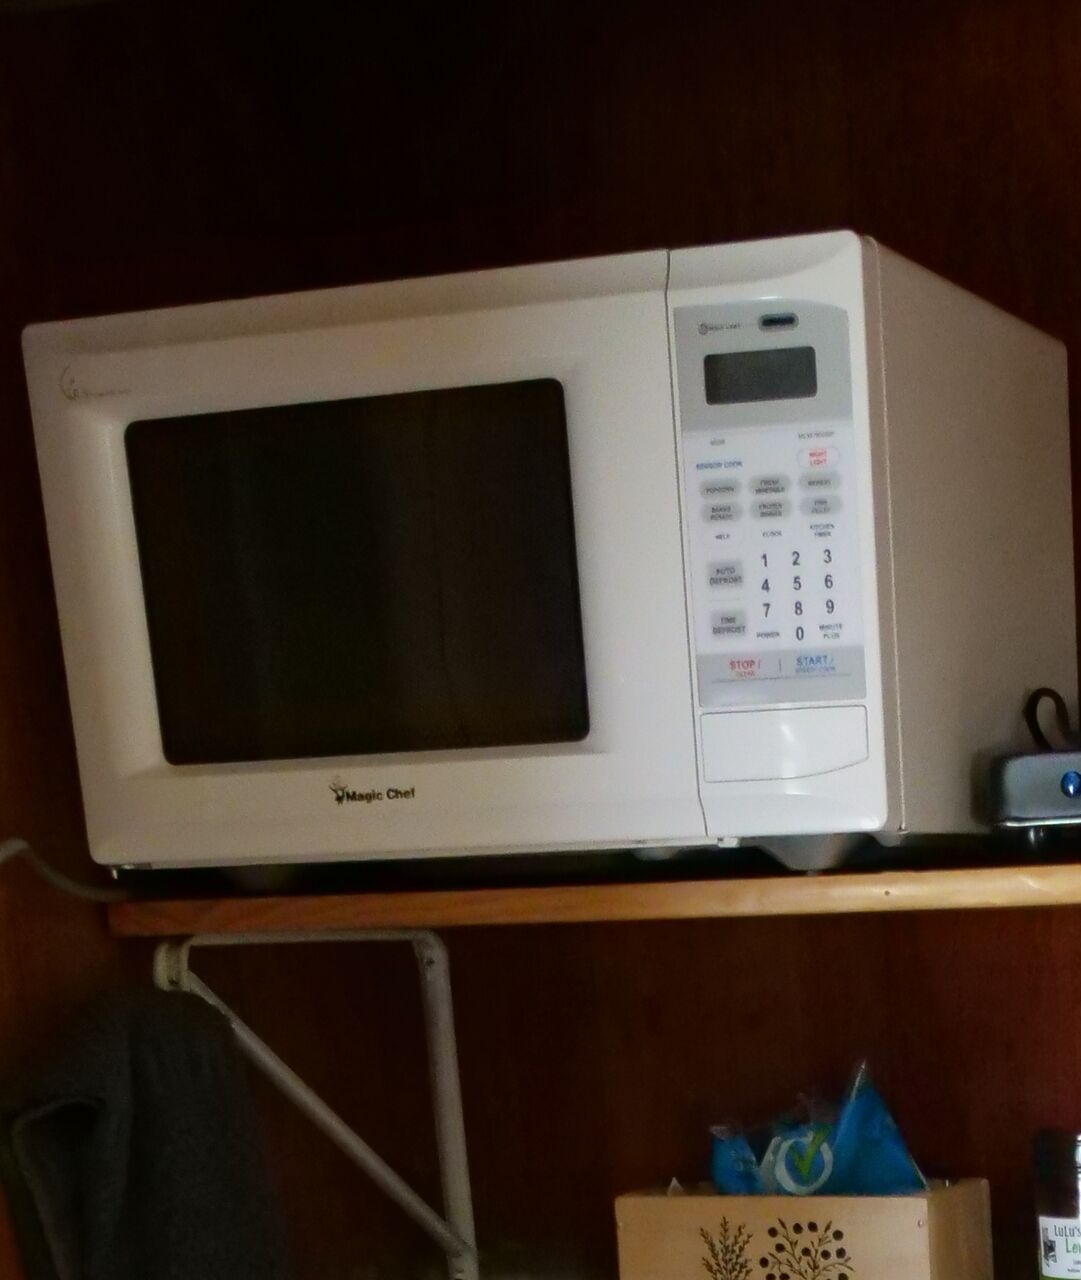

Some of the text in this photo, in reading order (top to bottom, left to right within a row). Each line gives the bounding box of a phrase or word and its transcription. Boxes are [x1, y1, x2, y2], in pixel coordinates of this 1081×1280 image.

[761, 549, 833, 567] 1 2 3
[761, 574, 834, 592] 4 5 6
[762, 599, 835, 618] 7 8 9
[795, 626, 804, 641] 0
[346, 786, 416, 803] Magic Chef
